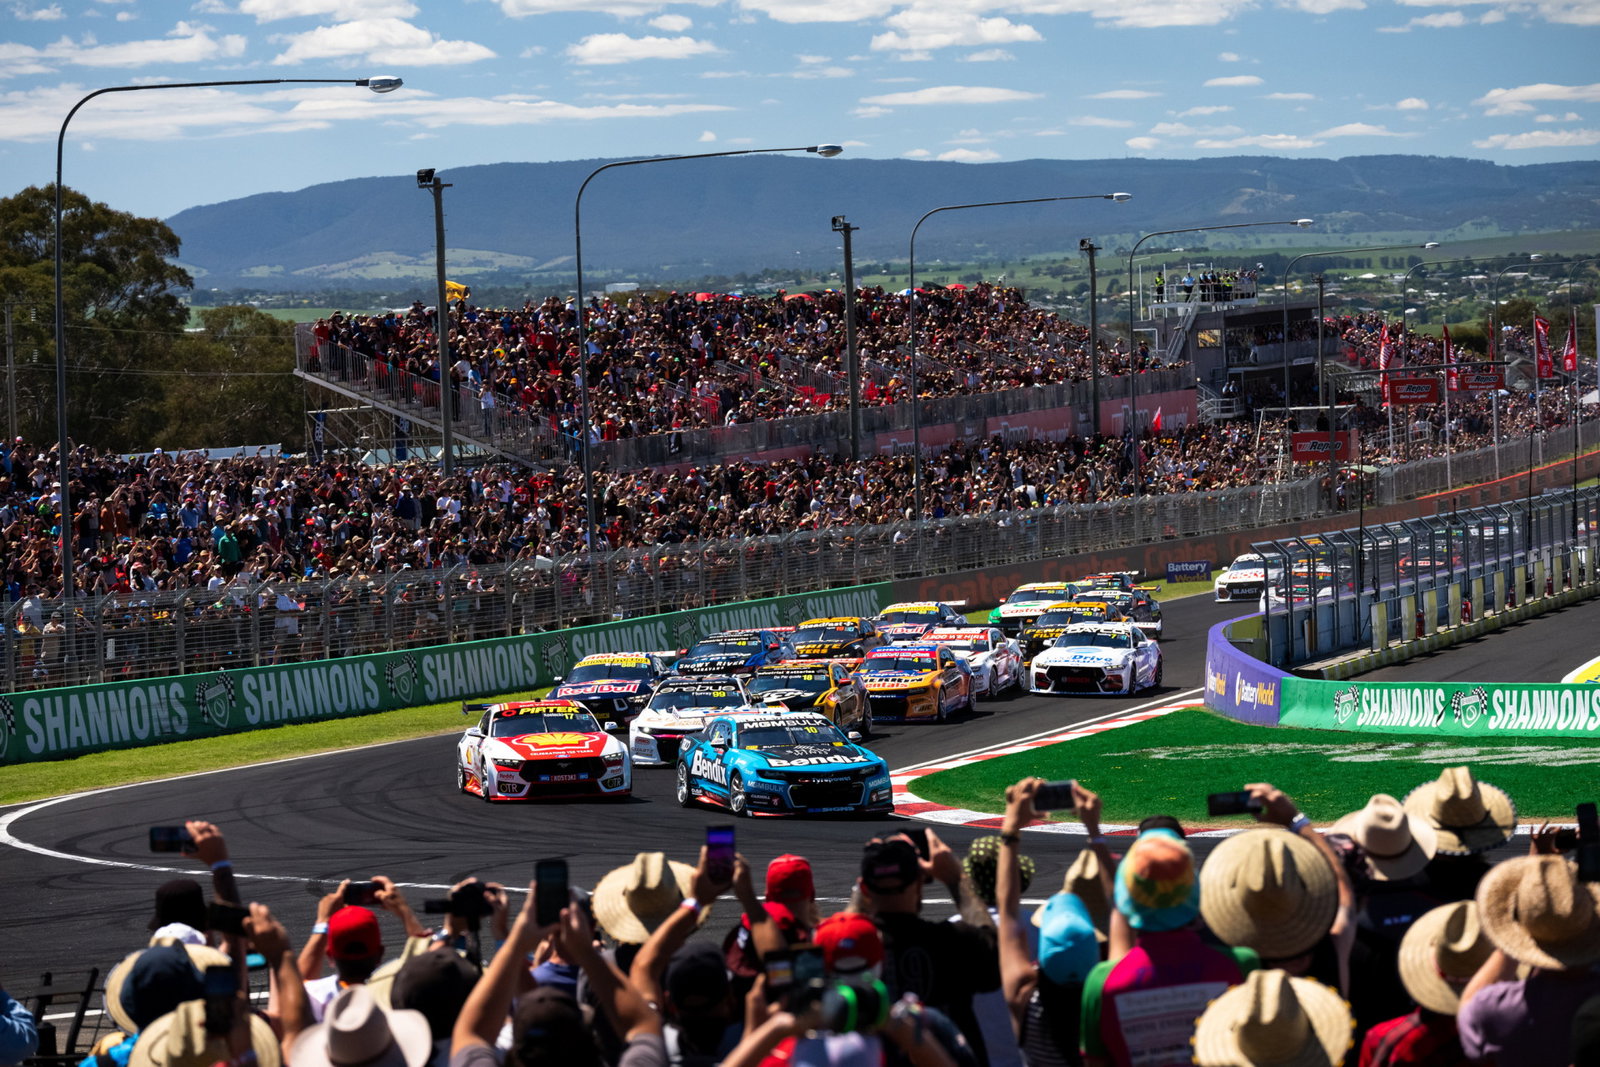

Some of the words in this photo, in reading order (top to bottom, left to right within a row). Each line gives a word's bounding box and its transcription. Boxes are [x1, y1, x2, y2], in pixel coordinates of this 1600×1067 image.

[1406, 384, 1432, 394] Repco
[1310, 440, 1343, 453] Repo
[1168, 562, 1207, 573] Battery
[1174, 573, 1207, 583] World
[1066, 626, 1127, 634] DAYCO
[573, 621, 668, 661] SHANNONS
[423, 641, 536, 699] SHANNONS
[679, 662, 711, 670] SNOWY
[242, 661, 381, 725] SHANNONS
[558, 685, 598, 698] Red
[598, 684, 640, 693] Bull
[519, 706, 580, 715] PIRTEK
[1356, 688, 1446, 728] SHANNONS
[1488, 689, 1600, 731] SHANNONS
[24, 682, 189, 755] SHANNONS
[744, 719, 826, 729] MGMBULK
[804, 726, 818, 734] 10
[766, 754, 869, 768] Bendix
[692, 750, 728, 787] Bendix
[500, 784, 518, 794] OTR
